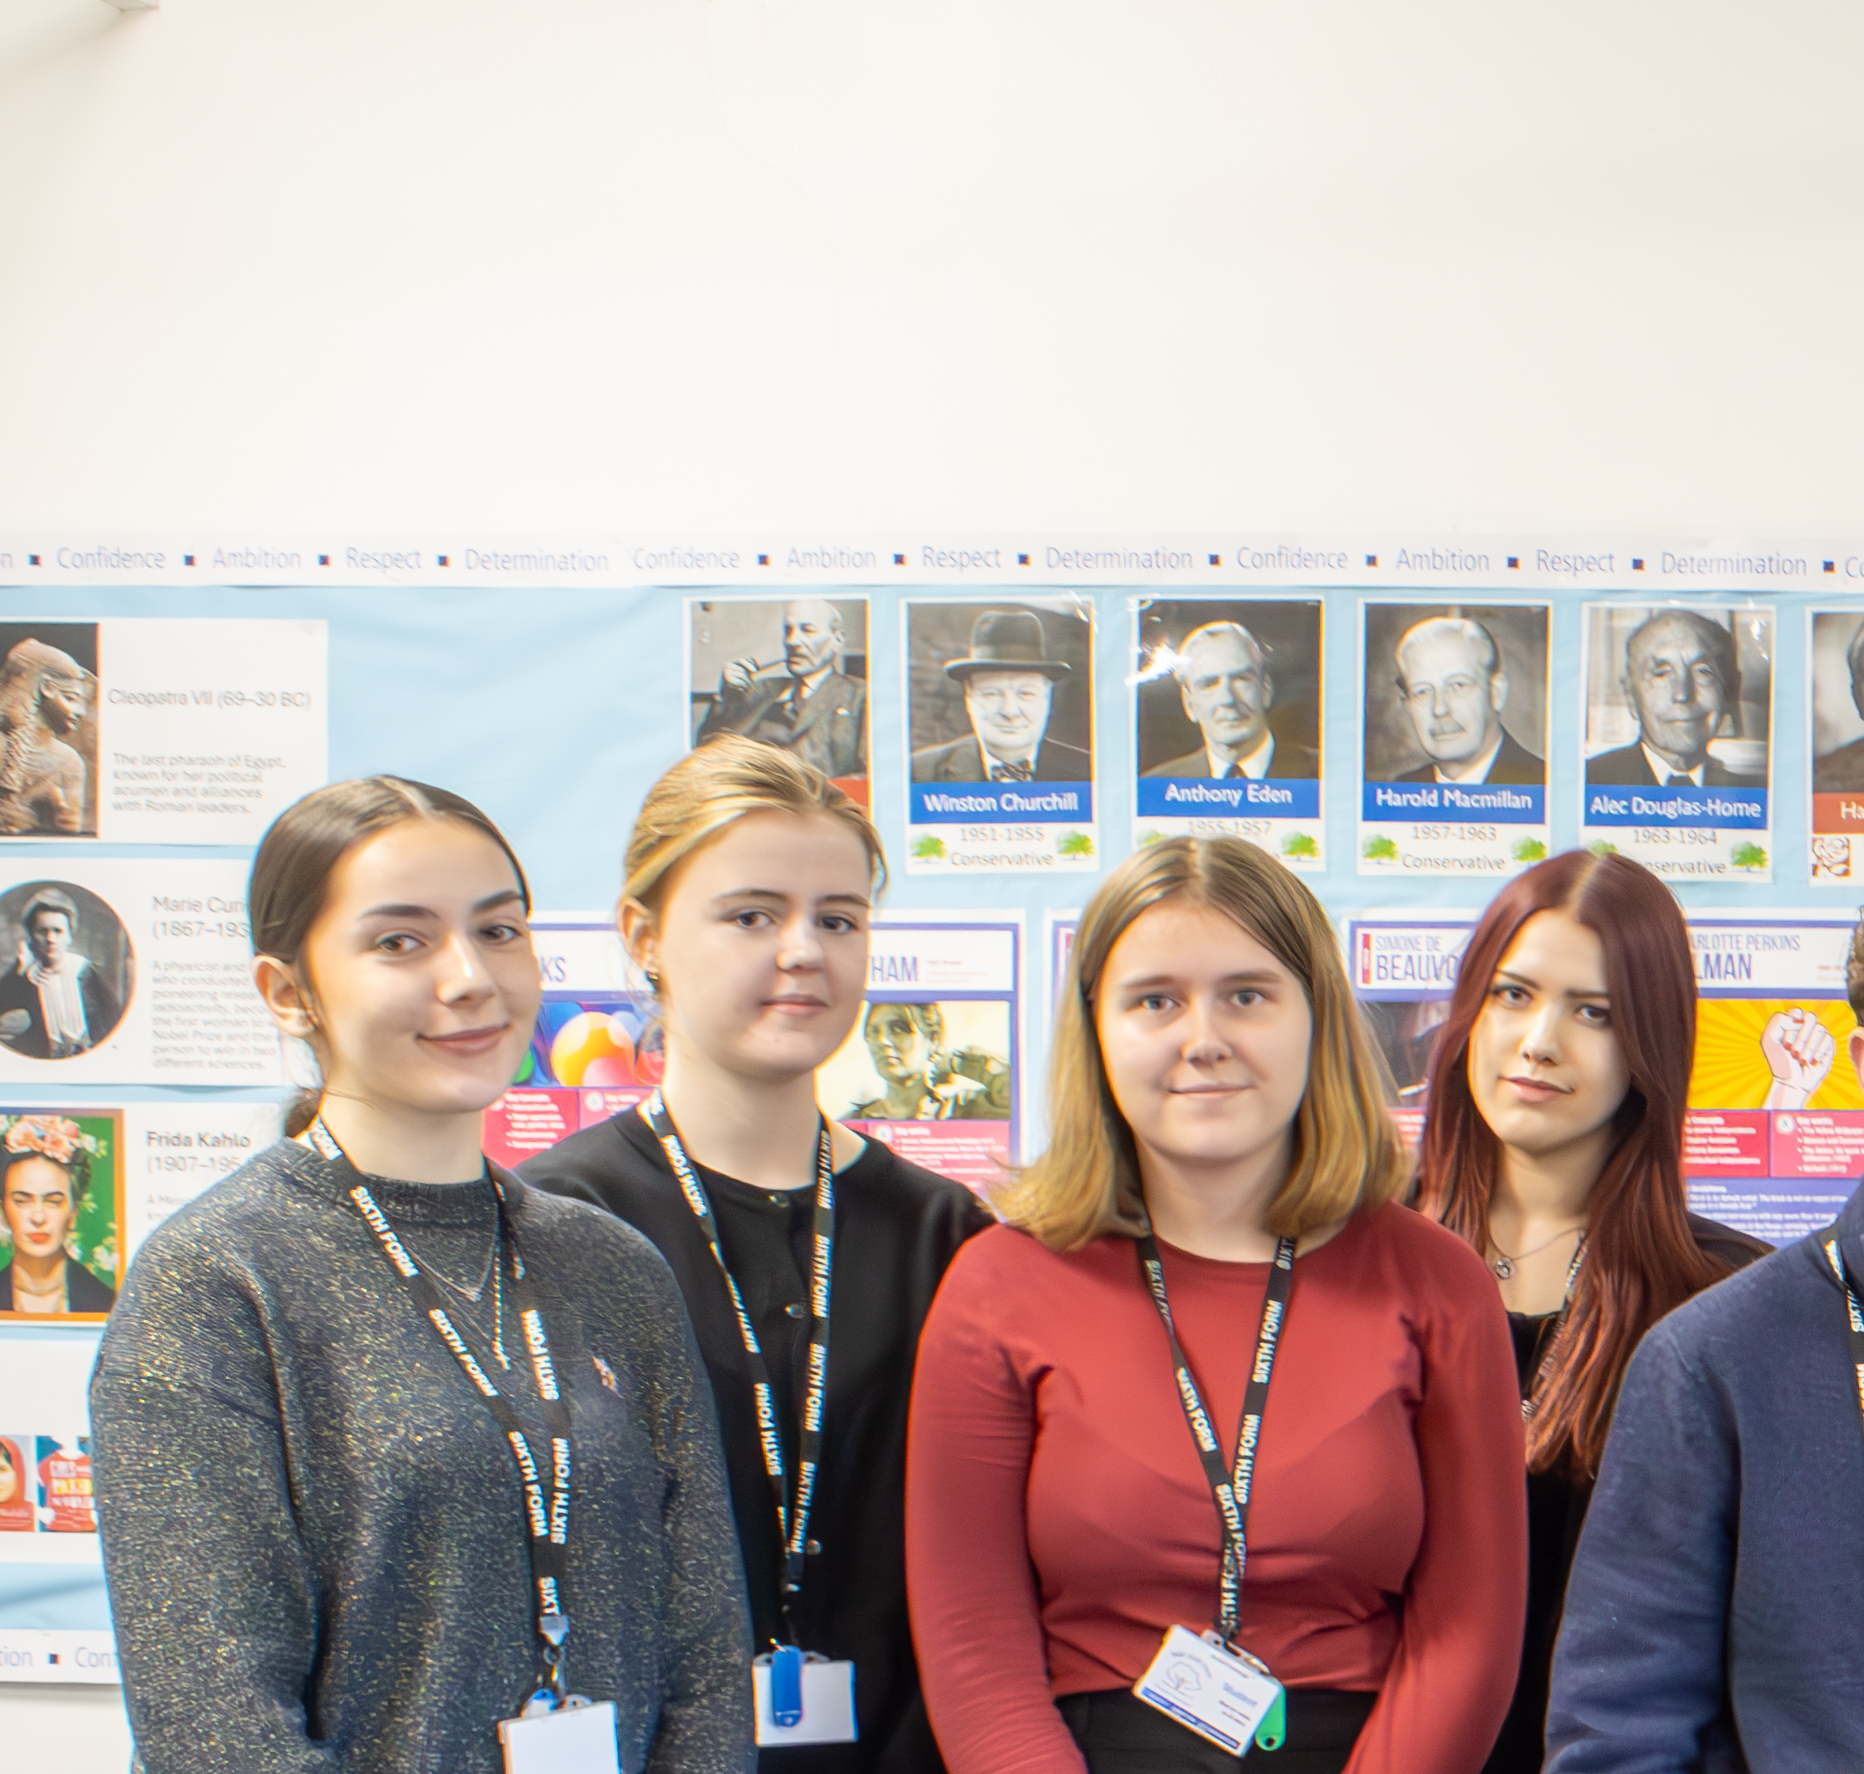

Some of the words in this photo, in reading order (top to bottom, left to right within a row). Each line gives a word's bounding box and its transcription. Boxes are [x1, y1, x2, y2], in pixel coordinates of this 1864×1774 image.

[58, 547, 165, 569] Confidence
[214, 548, 300, 568] Ambition
[347, 547, 421, 573] Respect
[466, 549, 607, 571] Determination
[634, 547, 739, 569] Confidence
[788, 547, 875, 568] Ambition
[923, 546, 1001, 573] Respect
[1047, 547, 1192, 569] Determination
[1237, 546, 1348, 569] Confidence
[1397, 548, 1489, 571] Ambition
[1537, 549, 1614, 577] Respect
[1662, 552, 1806, 575] Determination
[108, 686, 190, 709] Cleopatra
[194, 687, 214, 705] VII
[281, 690, 311, 711] BC)
[924, 792, 996, 813] Winston
[1000, 791, 1078, 813] Churchill
[1165, 782, 1243, 807] Anthony
[1247, 783, 1293, 804] Eden
[1376, 787, 1438, 809] Harold
[1443, 789, 1532, 811] Macmillan
[1590, 796, 1626, 816] Alec
[1630, 797, 1761, 821] Douglas-Home
[960, 828, 1045, 842] 1951-1955
[1412, 825, 1497, 842] 1957-1963
[1632, 827, 1718, 845] 1963-1964
[951, 850, 1054, 868] Conservative
[1402, 852, 1506, 870] Conservative
[153, 896, 202, 914] Marie
[147, 1130, 191, 1149] Frida
[198, 1131, 251, 1149] Kahlo
[352, 1186, 391, 1236] SIXTH
[382, 1231, 418, 1278] FORM
[522, 1310, 546, 1353] FORM
[1261, 1300, 1284, 1337] FORM
[429, 1308, 468, 1356] SIXTH
[462, 1351, 500, 1398] FORM
[809, 1343, 826, 1387] SIXTH
[1253, 1339, 1275, 1384] SIXTH
[538, 1354, 560, 1401] SIXTH
[805, 1388, 821, 1432] FORM
[1240, 1414, 1261, 1456] FORM
[553, 1437, 571, 1487] FORM
[508, 1430, 540, 1481] SIXTH
[527, 1483, 548, 1538] FORM
[550, 1490, 569, 1545] SIXTH
